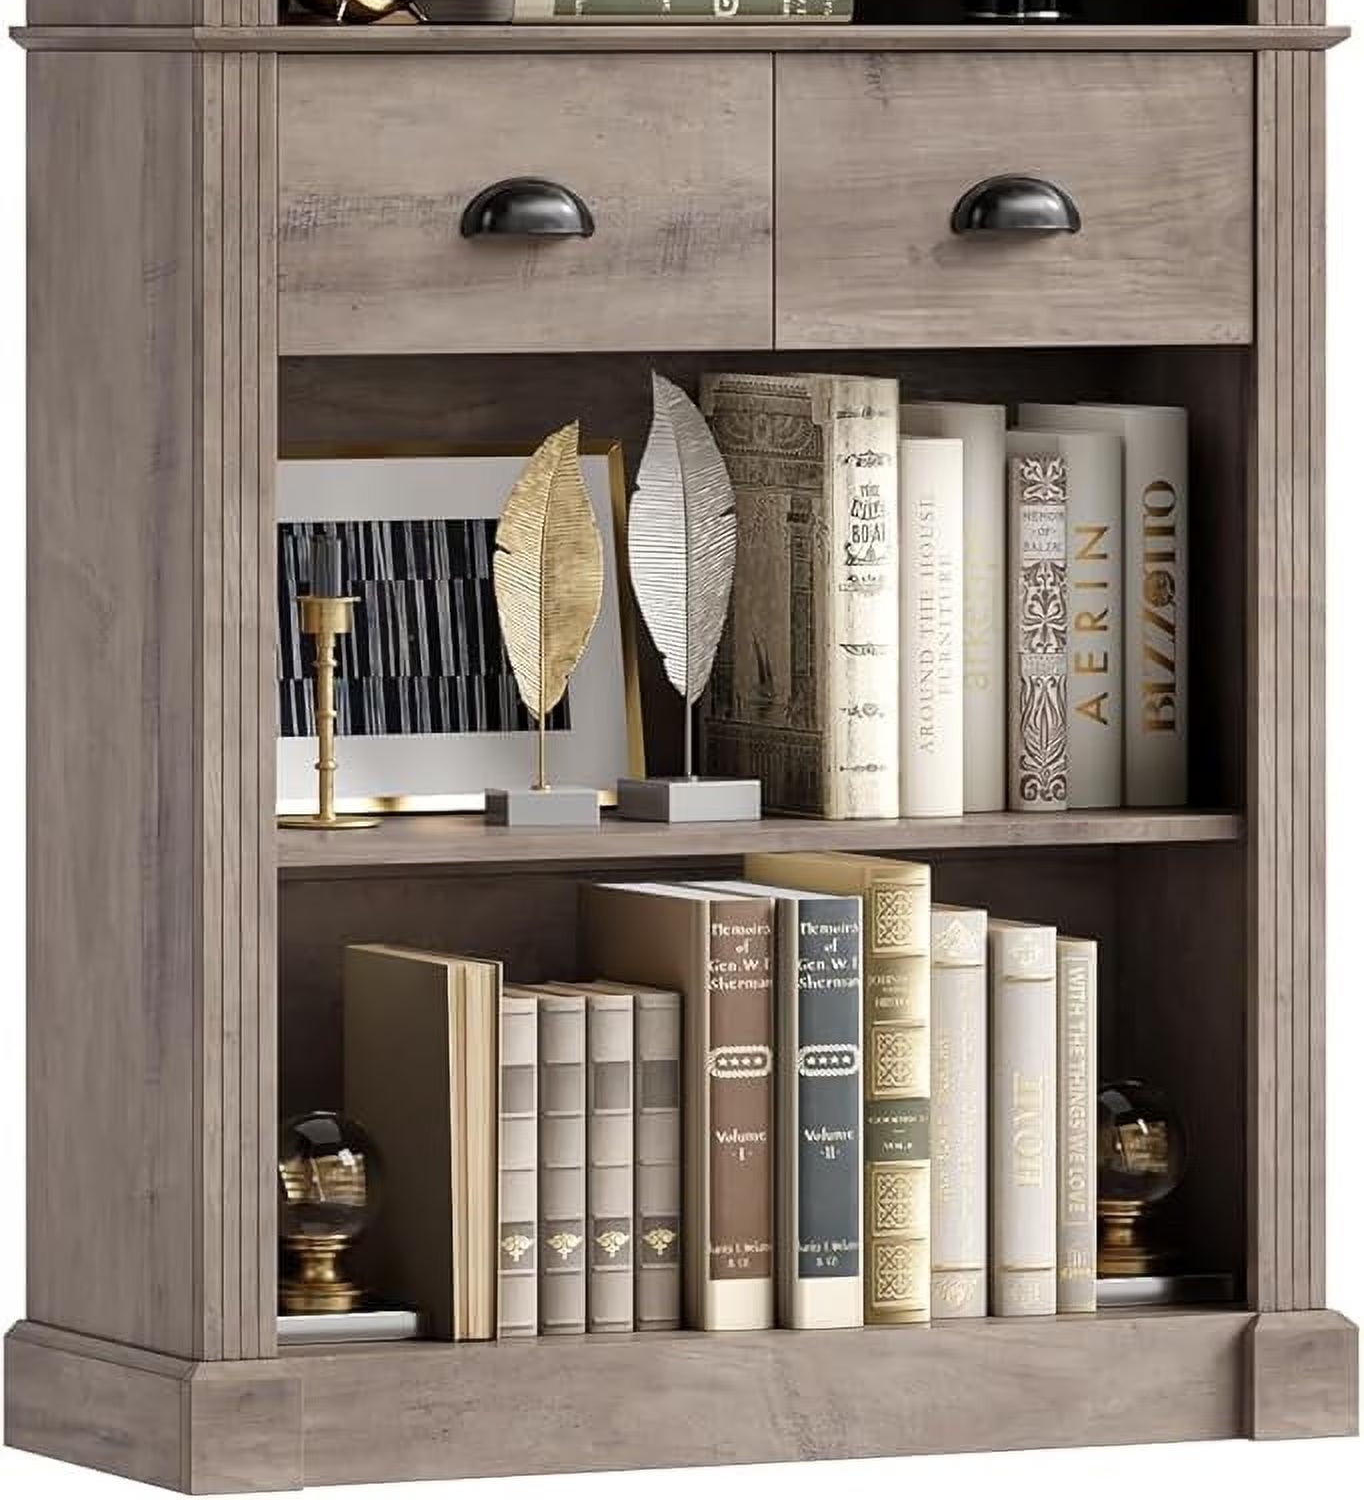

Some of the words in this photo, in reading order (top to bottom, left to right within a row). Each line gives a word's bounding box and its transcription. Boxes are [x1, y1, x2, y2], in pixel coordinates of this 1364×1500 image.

[918, 589, 935, 636] THE
[1142, 479, 1178, 735] BIZZOTTO
[1074, 524, 1109, 726] AERIN
[918, 649, 935, 755] AROUND
[711, 922, 771, 937] Memoirs
[735, 937, 751, 954] of
[800, 922, 859, 936] Memoirs
[706, 976, 773, 990] Sherman
[798, 973, 860, 989] Sherman
[1069, 967, 1089, 1016] WITH
[1068, 1023, 1088, 1059] THE
[1068, 1060, 1088, 1131] THINGS
[715, 1128, 767, 1143] Volume
[804, 1126, 855, 1141] Volume
[1068, 1134, 1087, 1165] WE
[1068, 1169, 1087, 1214] LOVE
